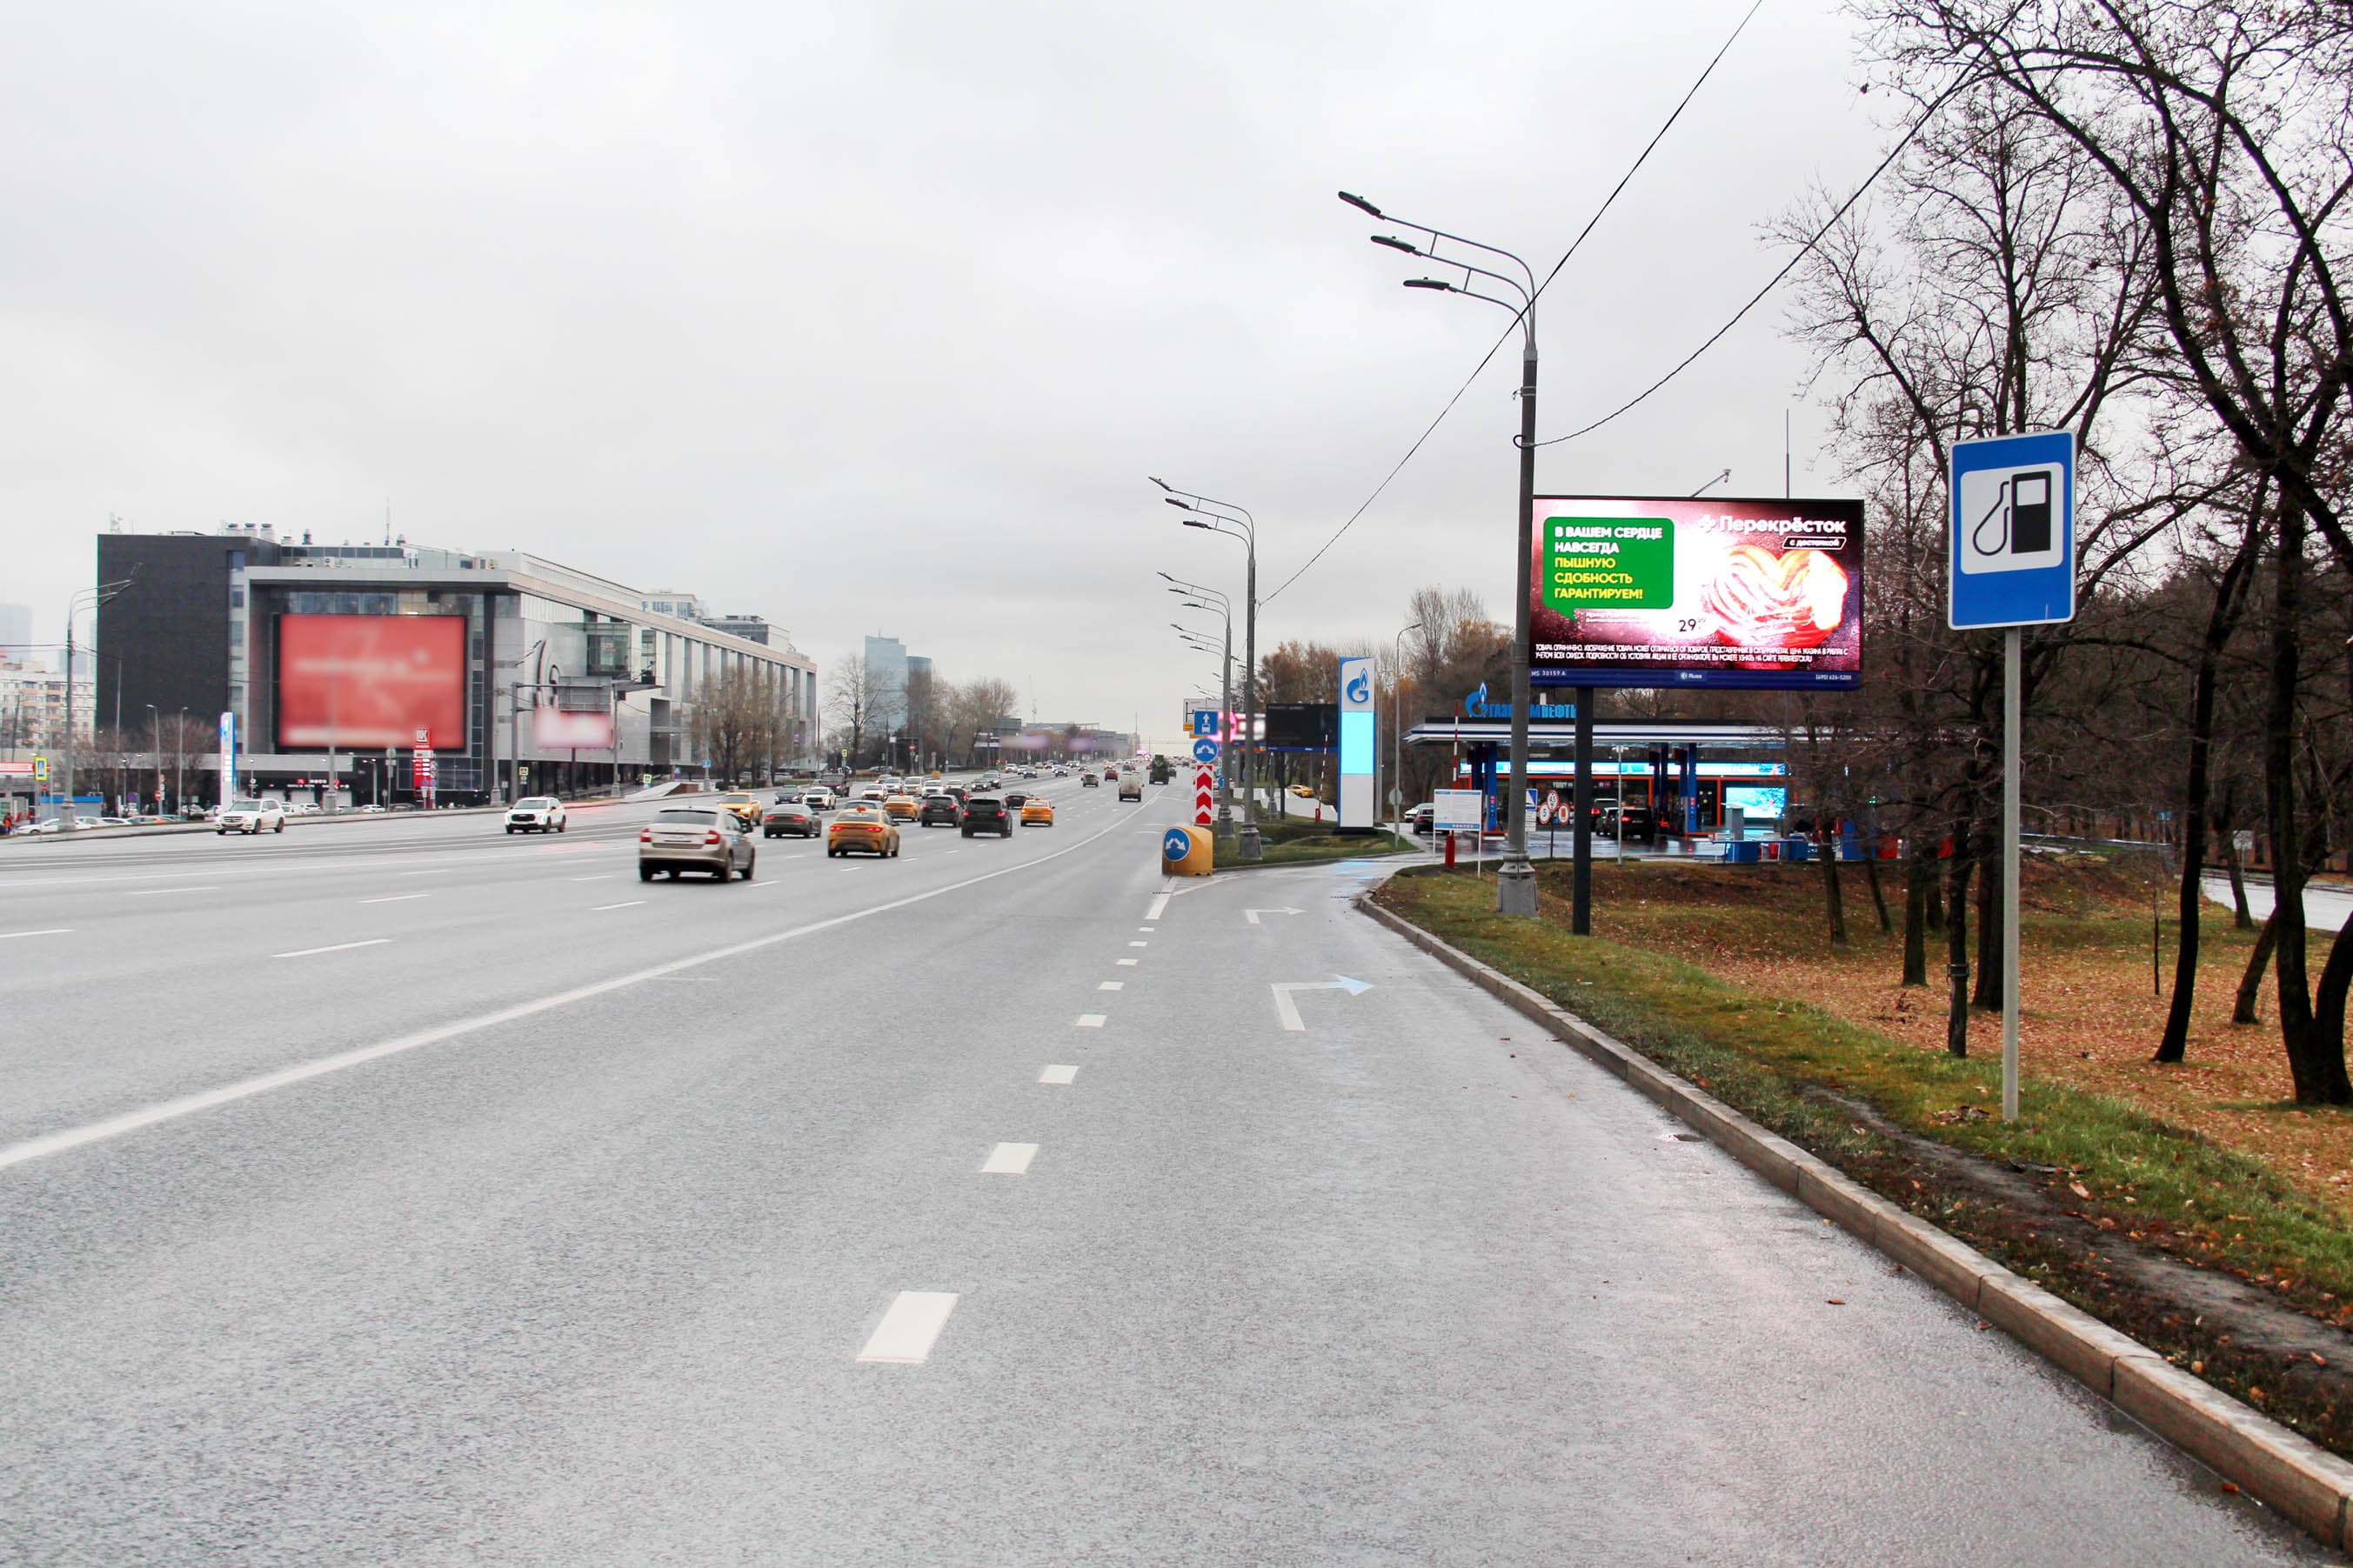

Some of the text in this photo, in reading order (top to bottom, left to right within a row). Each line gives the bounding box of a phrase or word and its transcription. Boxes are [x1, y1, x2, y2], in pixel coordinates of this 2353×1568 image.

[1719, 516, 1846, 535] Перекрёсток
[1554, 526, 1663, 540] В ВАШЕМ СЕРДЦЕ
[1554, 542, 1620, 555] НАВСЕГДА
[1554, 557, 1616, 569] ПЫШНУЮ
[1554, 572, 1634, 584] СДОБНОСТЬ
[1554, 588, 1643, 599] ГАРАНТИРУЕМ!
[1678, 618, 1697, 632] 29
